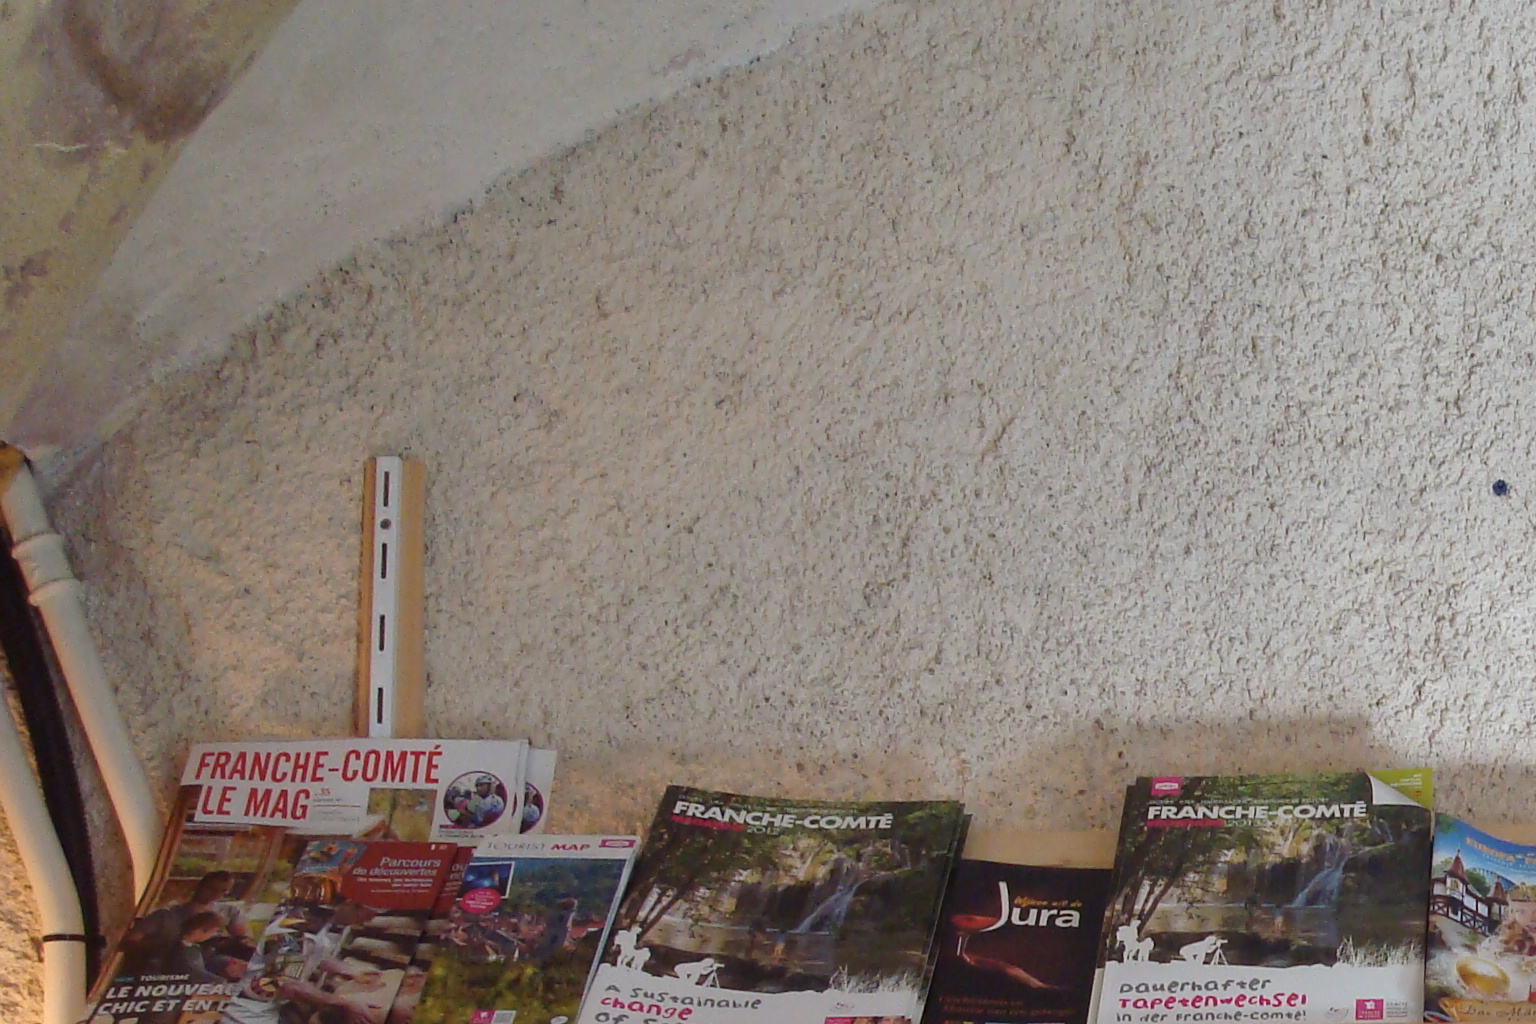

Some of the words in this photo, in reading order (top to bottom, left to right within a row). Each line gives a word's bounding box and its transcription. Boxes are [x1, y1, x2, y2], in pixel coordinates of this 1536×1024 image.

[195, 744, 443, 784] FRANCHE-COMTÉ
[201, 785, 237, 816] LE
[243, 788, 311, 820] MAG
[673, 800, 894, 830] FRANCHE-COMTÉ
[1147, 801, 1368, 821] FRANCHE-COMTÉ
[551, 843, 591, 851] MAP
[380, 857, 442, 868] Parcours
[369, 866, 438, 877] découvertes
[979, 881, 1082, 933] Jura
[105, 986, 133, 999] LE
[604, 984, 621, 993] A
[1119, 978, 1272, 994] Dauerhafter
[97, 1000, 149, 1015] CHIC
[151, 999, 181, 1012] ET
[600, 997, 693, 1021] change
[1118, 992, 1307, 1010] Tapetenwechsel
[1116, 1011, 1132, 1023] in
[1139, 1011, 1168, 1023] der
